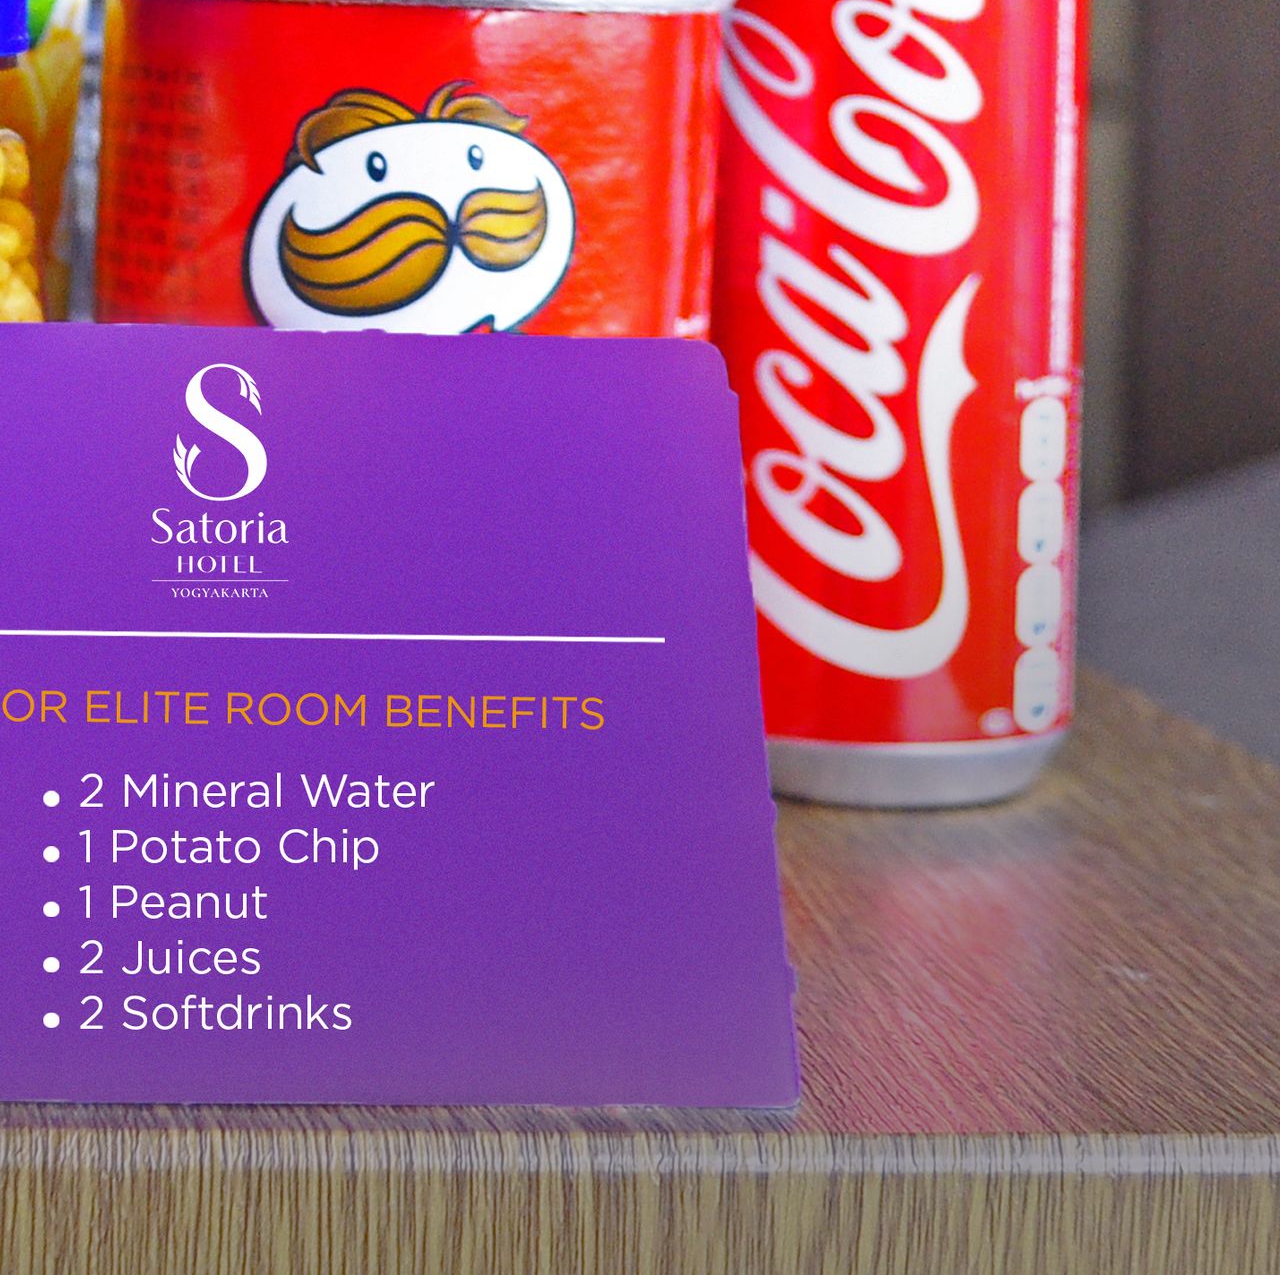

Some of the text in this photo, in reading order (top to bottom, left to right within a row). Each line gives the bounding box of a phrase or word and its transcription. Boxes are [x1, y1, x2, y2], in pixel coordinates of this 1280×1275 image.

[151, 507, 290, 544] Satoria
[177, 555, 263, 574] HOTEL
[171, 587, 269, 598] YOGYAKARTA
[86, 691, 209, 724] ELITE
[227, 692, 366, 726] ROOM
[386, 695, 605, 730] BENEFITS
[80, 773, 435, 808] 2 Mineral Water
[79, 828, 379, 870] 1 Potato Chip
[79, 885, 268, 919] 1 Peanut
[80, 940, 261, 974] 2 Juices
[80, 995, 352, 1030] 2 Softdrinks
